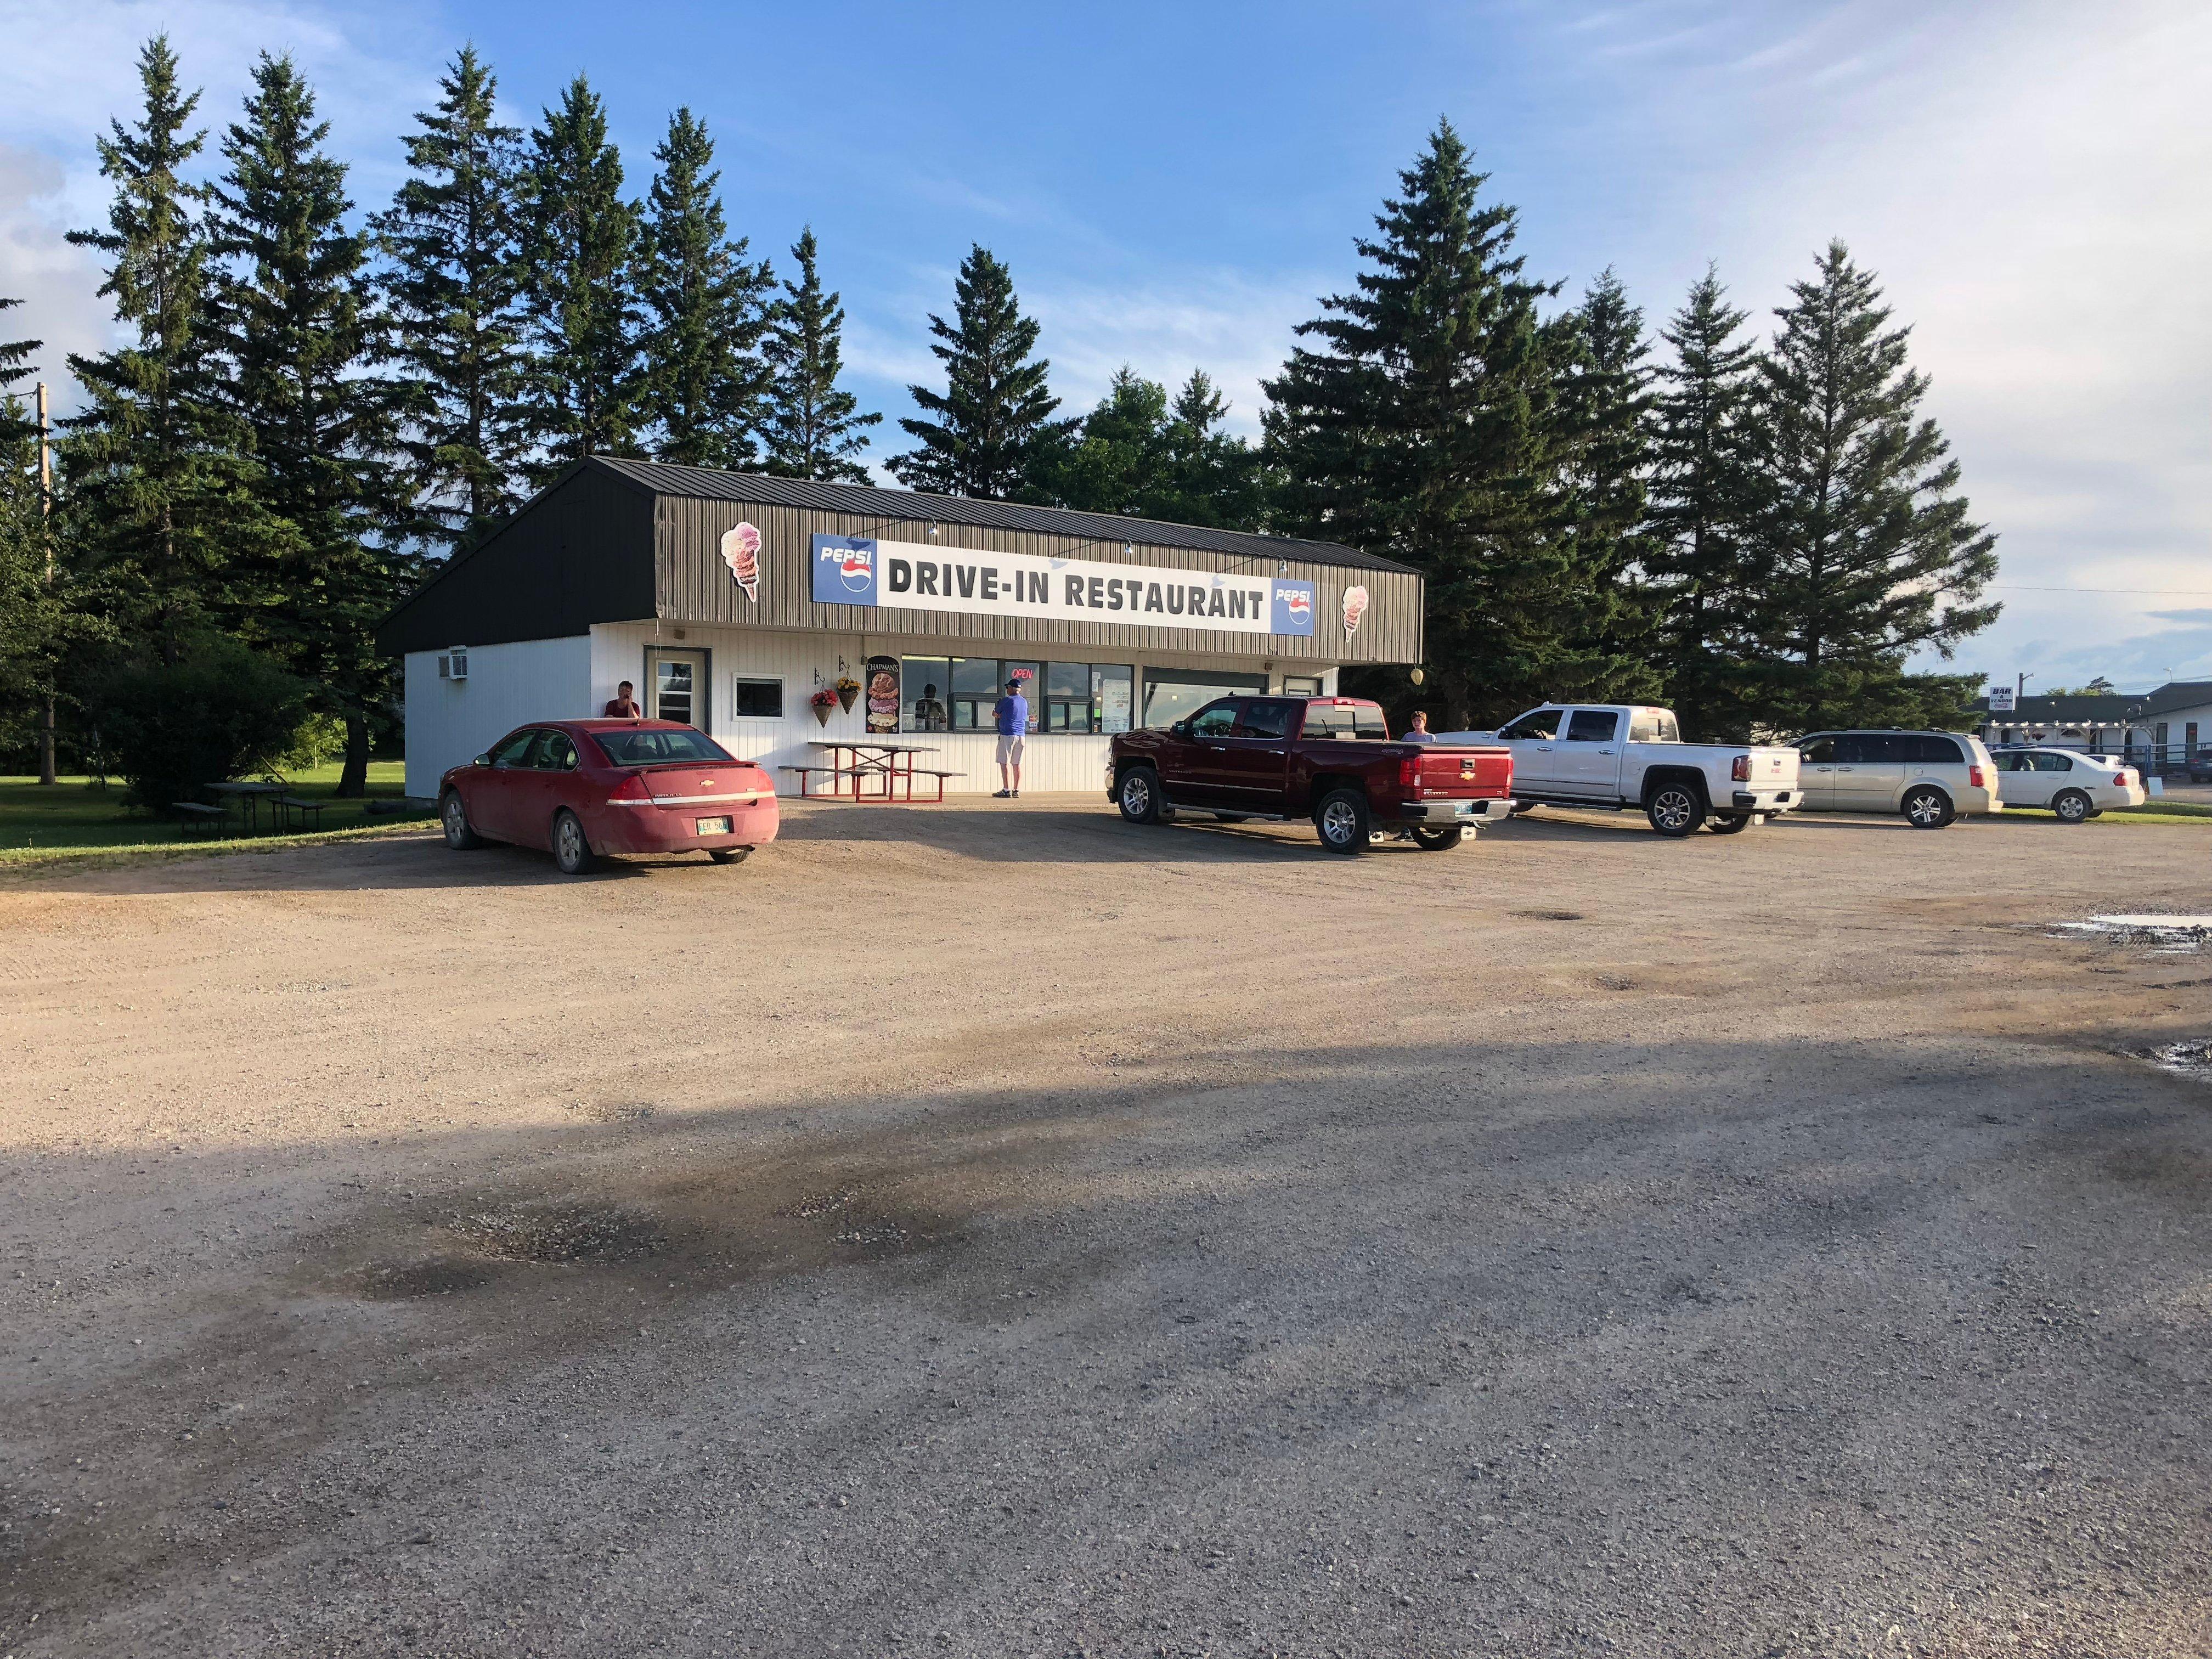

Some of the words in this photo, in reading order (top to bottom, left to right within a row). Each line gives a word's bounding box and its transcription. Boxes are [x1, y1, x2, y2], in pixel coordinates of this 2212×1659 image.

[820, 546, 872, 565] PEPSI
[889, 558, 1048, 603] DRIVE-IN
[1065, 574, 1263, 619] RESTAURANT
[1276, 589, 1311, 602] PEPSI
[867, 663, 899, 672] CHAPMAN'S
[1012, 668, 1033, 679] OPEN
